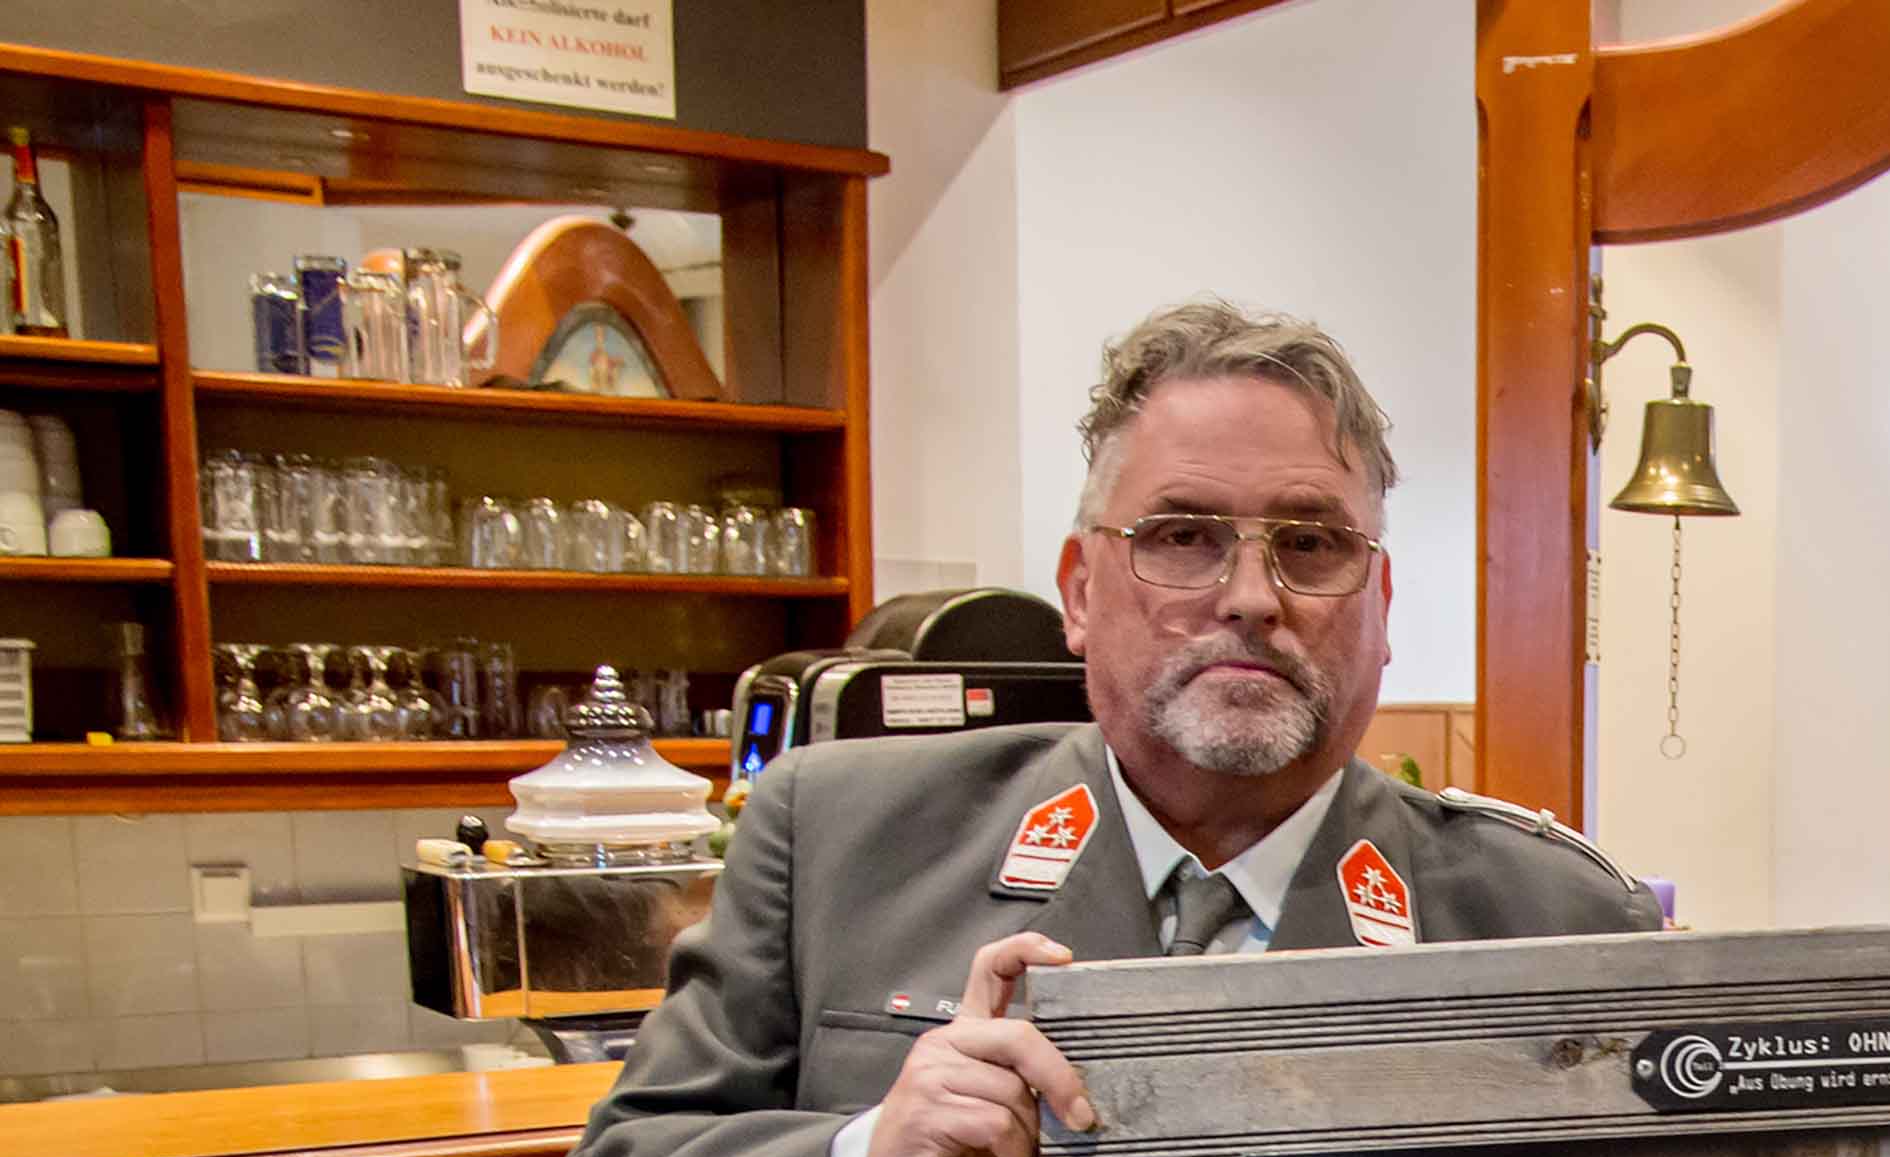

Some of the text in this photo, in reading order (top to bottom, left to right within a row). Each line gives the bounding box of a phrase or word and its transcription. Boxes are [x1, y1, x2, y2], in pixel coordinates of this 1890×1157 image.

[490, 24, 645, 61] KEIN ALKOHOL
[476, 61, 591, 88] ausgeschenkt
[1728, 1036, 1831, 1060] Zyklus:
[1821, 1070, 1856, 1088] wird
